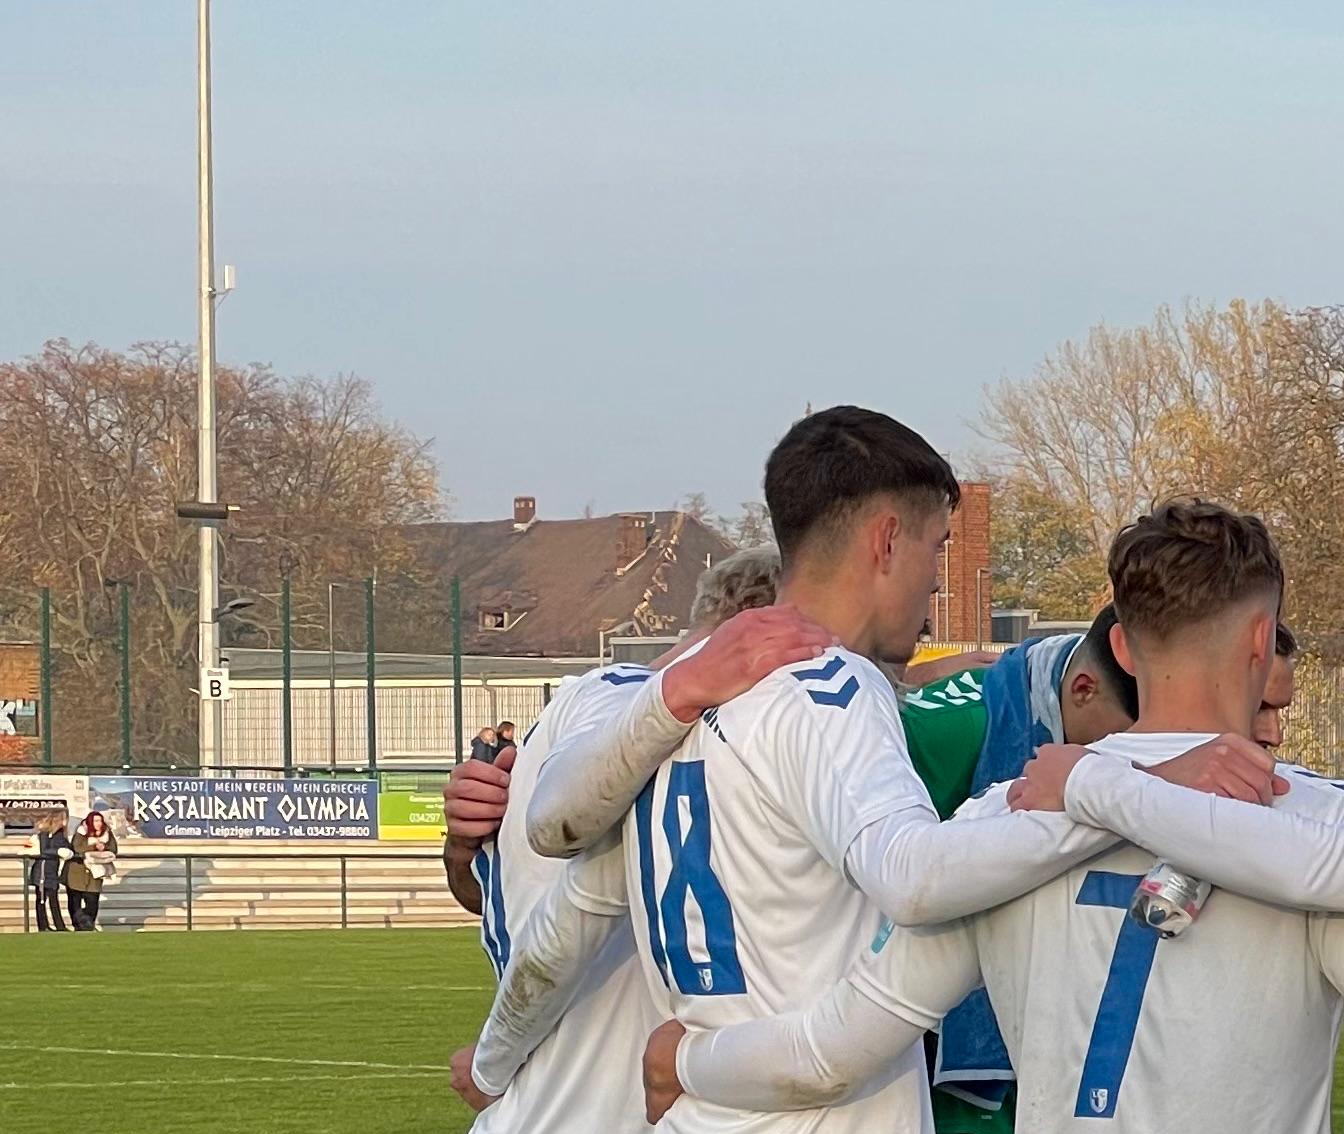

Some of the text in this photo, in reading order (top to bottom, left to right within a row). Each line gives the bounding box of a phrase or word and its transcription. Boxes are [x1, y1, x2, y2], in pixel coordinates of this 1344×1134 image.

[210, 679, 222, 698] B
[133, 780, 169, 792] MEINE
[214, 782, 243, 793] MEIN
[293, 783, 321, 793] MEIN
[322, 783, 368, 794] GRIECHE
[132, 793, 369, 822] RESTAURANT OLYMPIA
[164, 824, 202, 836] Grimma
[209, 824, 254, 838] Leipziger
[255, 825, 280, 836] Platz
[1073, 868, 1168, 1120] 7
